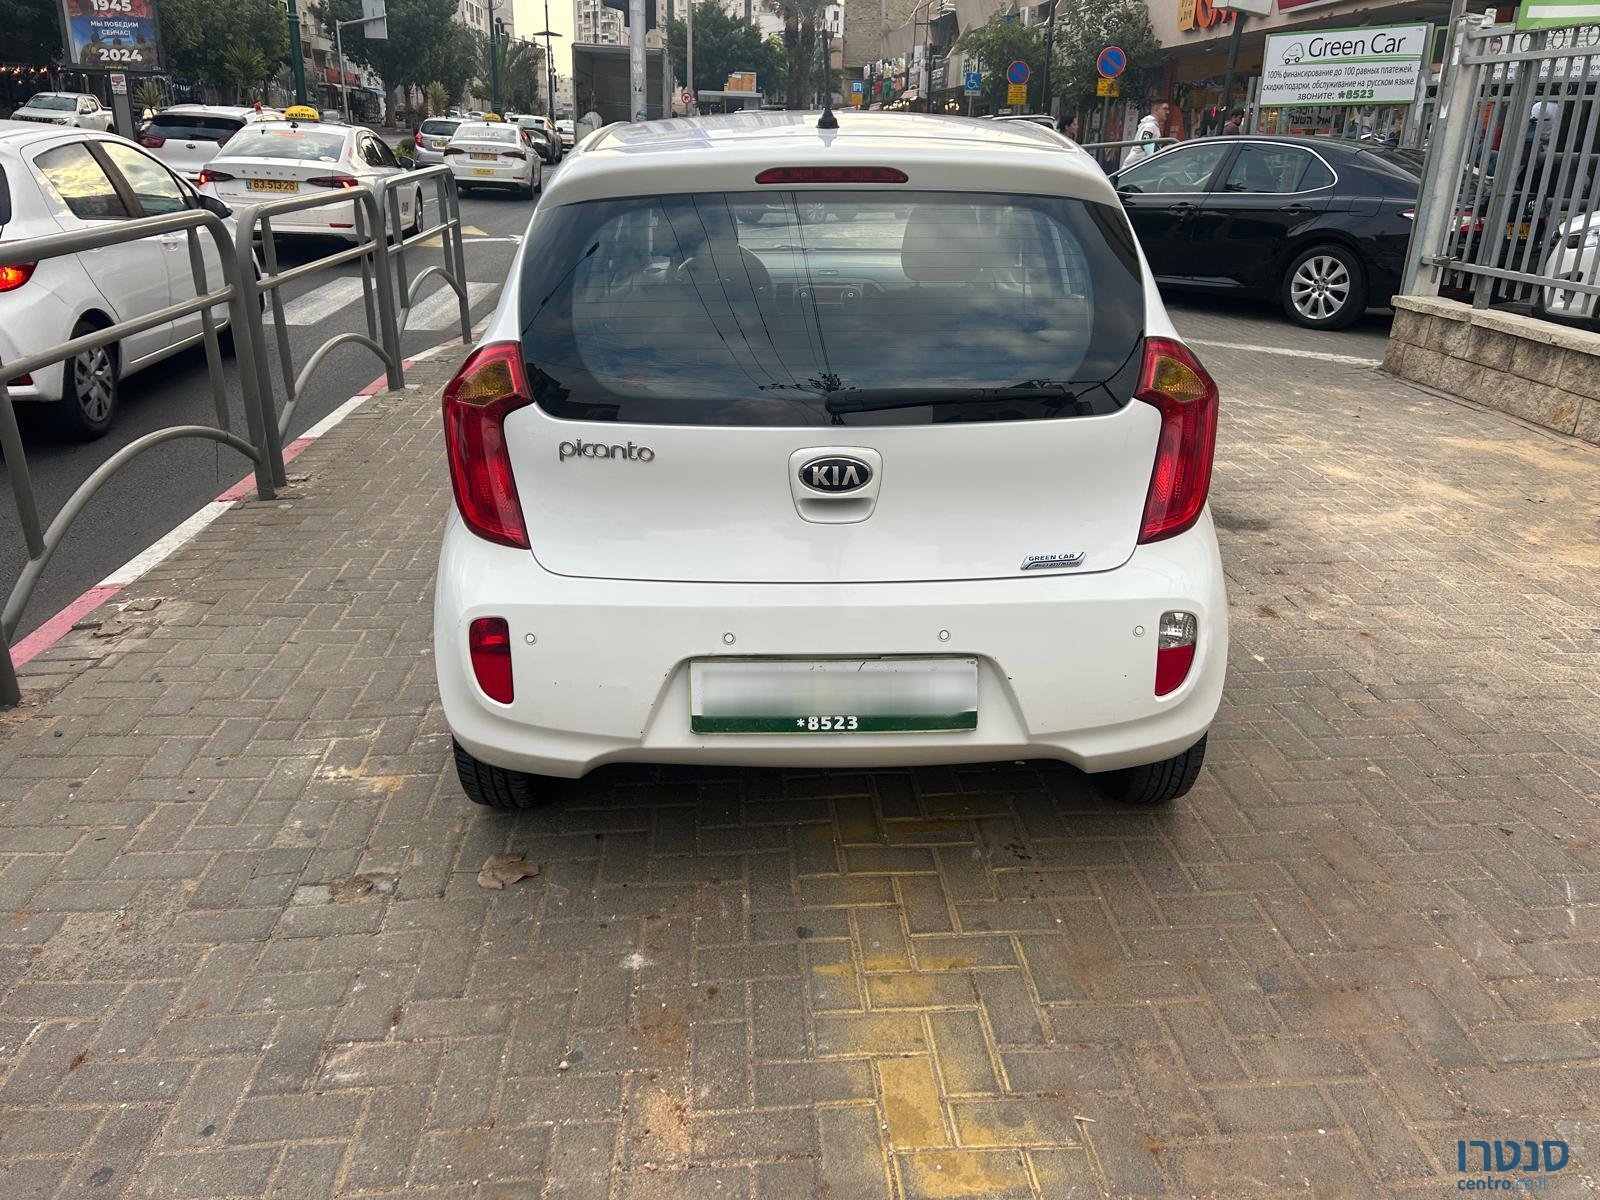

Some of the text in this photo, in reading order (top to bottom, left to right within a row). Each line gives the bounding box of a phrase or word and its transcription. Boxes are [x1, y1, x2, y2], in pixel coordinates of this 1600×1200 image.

[91, 0, 132, 12] 1945
[1308, 33, 1406, 57] Green Car
[99, 48, 143, 62] 2024
[1267, 70, 1282, 79] 100%
[1283, 68, 1334, 79] финансирование
[1333, 68, 1342, 77] до
[1344, 66, 1356, 76] 100
[1356, 67, 1380, 77] равных
[1312, 80, 1357, 92] обслуживание
[1366, 79, 1394, 89] русском
[1297, 92, 1335, 101] звоните:
[559, 438, 655, 462] picanto
[811, 465, 861, 486] KIA
